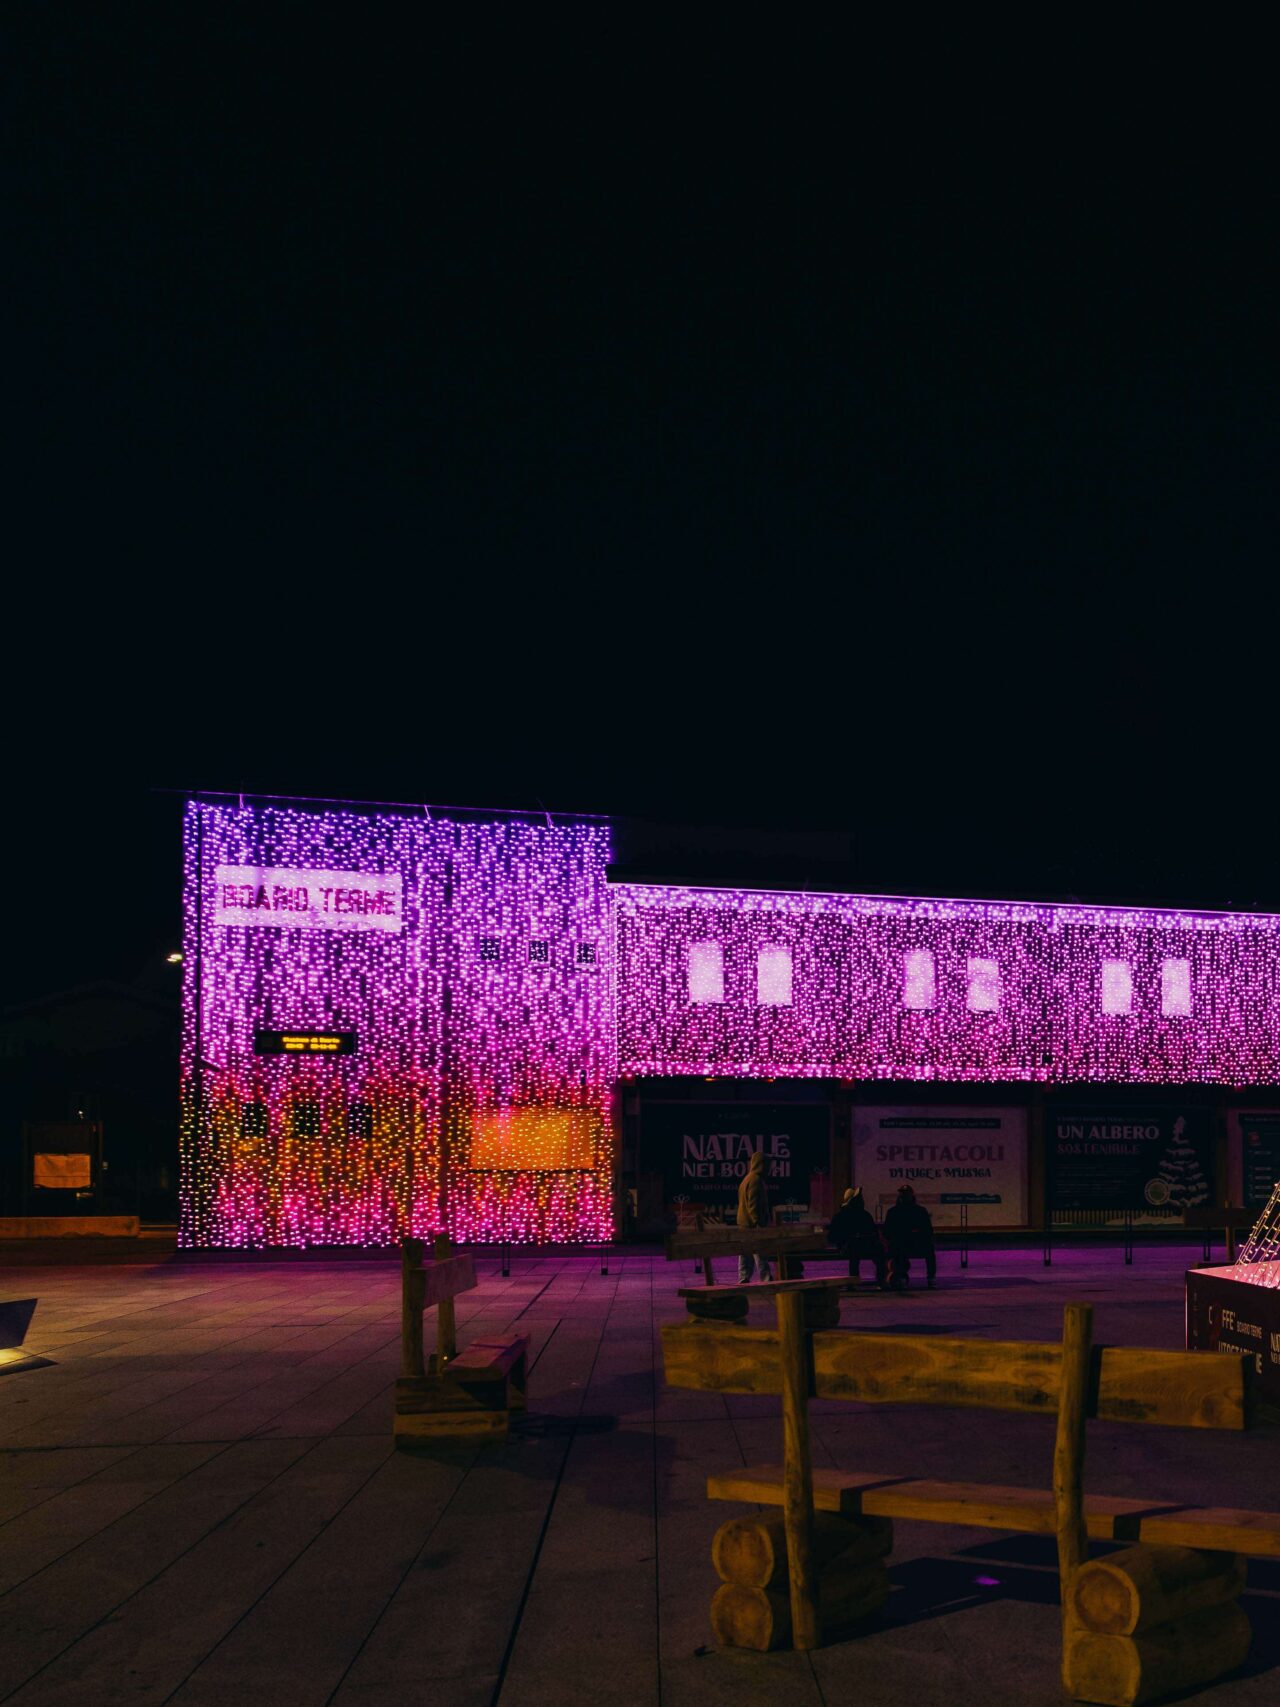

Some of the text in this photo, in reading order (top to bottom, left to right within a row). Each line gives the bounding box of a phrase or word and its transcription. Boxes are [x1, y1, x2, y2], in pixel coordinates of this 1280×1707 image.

[223, 884, 396, 915] BOARIO TERME
[1057, 1124, 1159, 1140] UN ALBERO
[683, 1133, 791, 1161] NATALE
[876, 1145, 1004, 1161] SPETTACOLI
[683, 1162, 715, 1177] NEI
[944, 1167, 991, 1178] MUSICA
